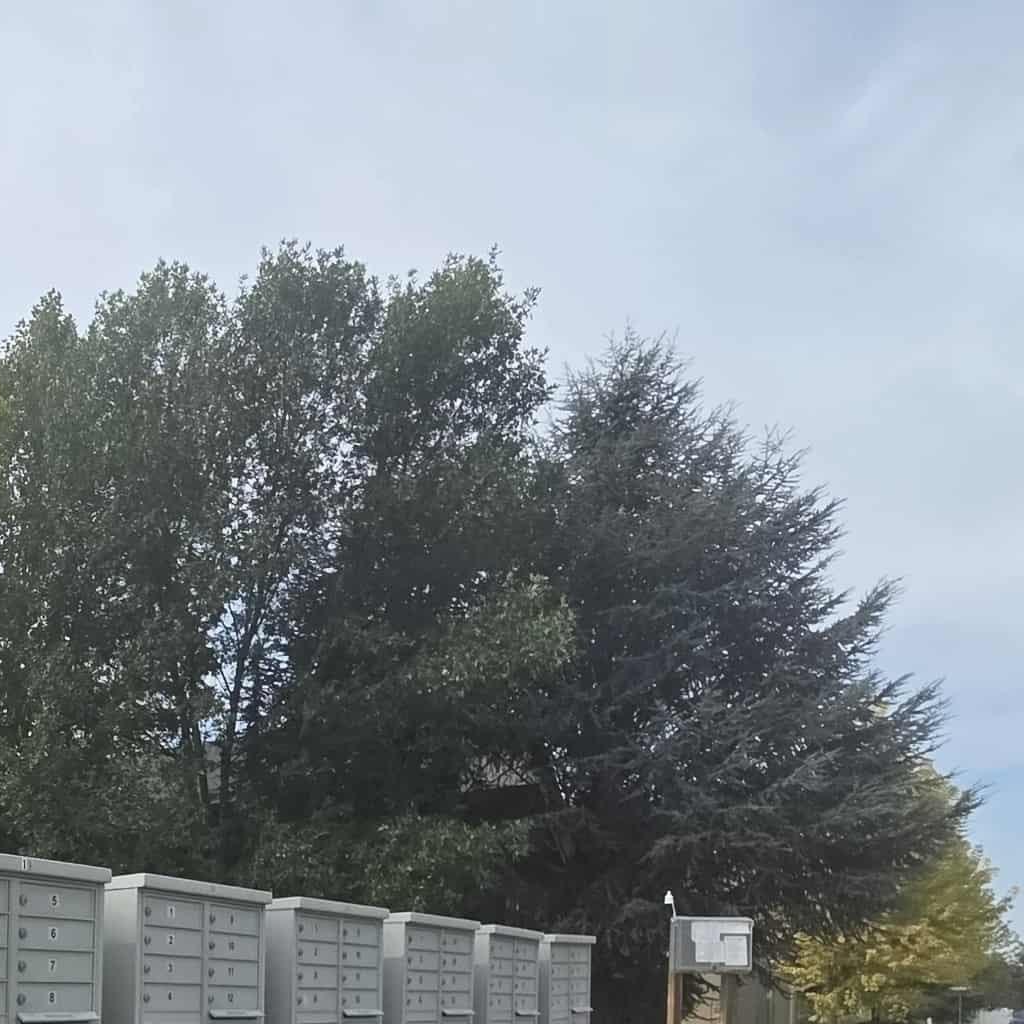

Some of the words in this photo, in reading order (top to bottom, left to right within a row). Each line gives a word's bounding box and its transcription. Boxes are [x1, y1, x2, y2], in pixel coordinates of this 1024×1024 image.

[51, 895, 57, 906] 5
[50, 928, 56, 939] 6
[50, 960, 56, 971] 7
[49, 992, 55, 1002] 8
